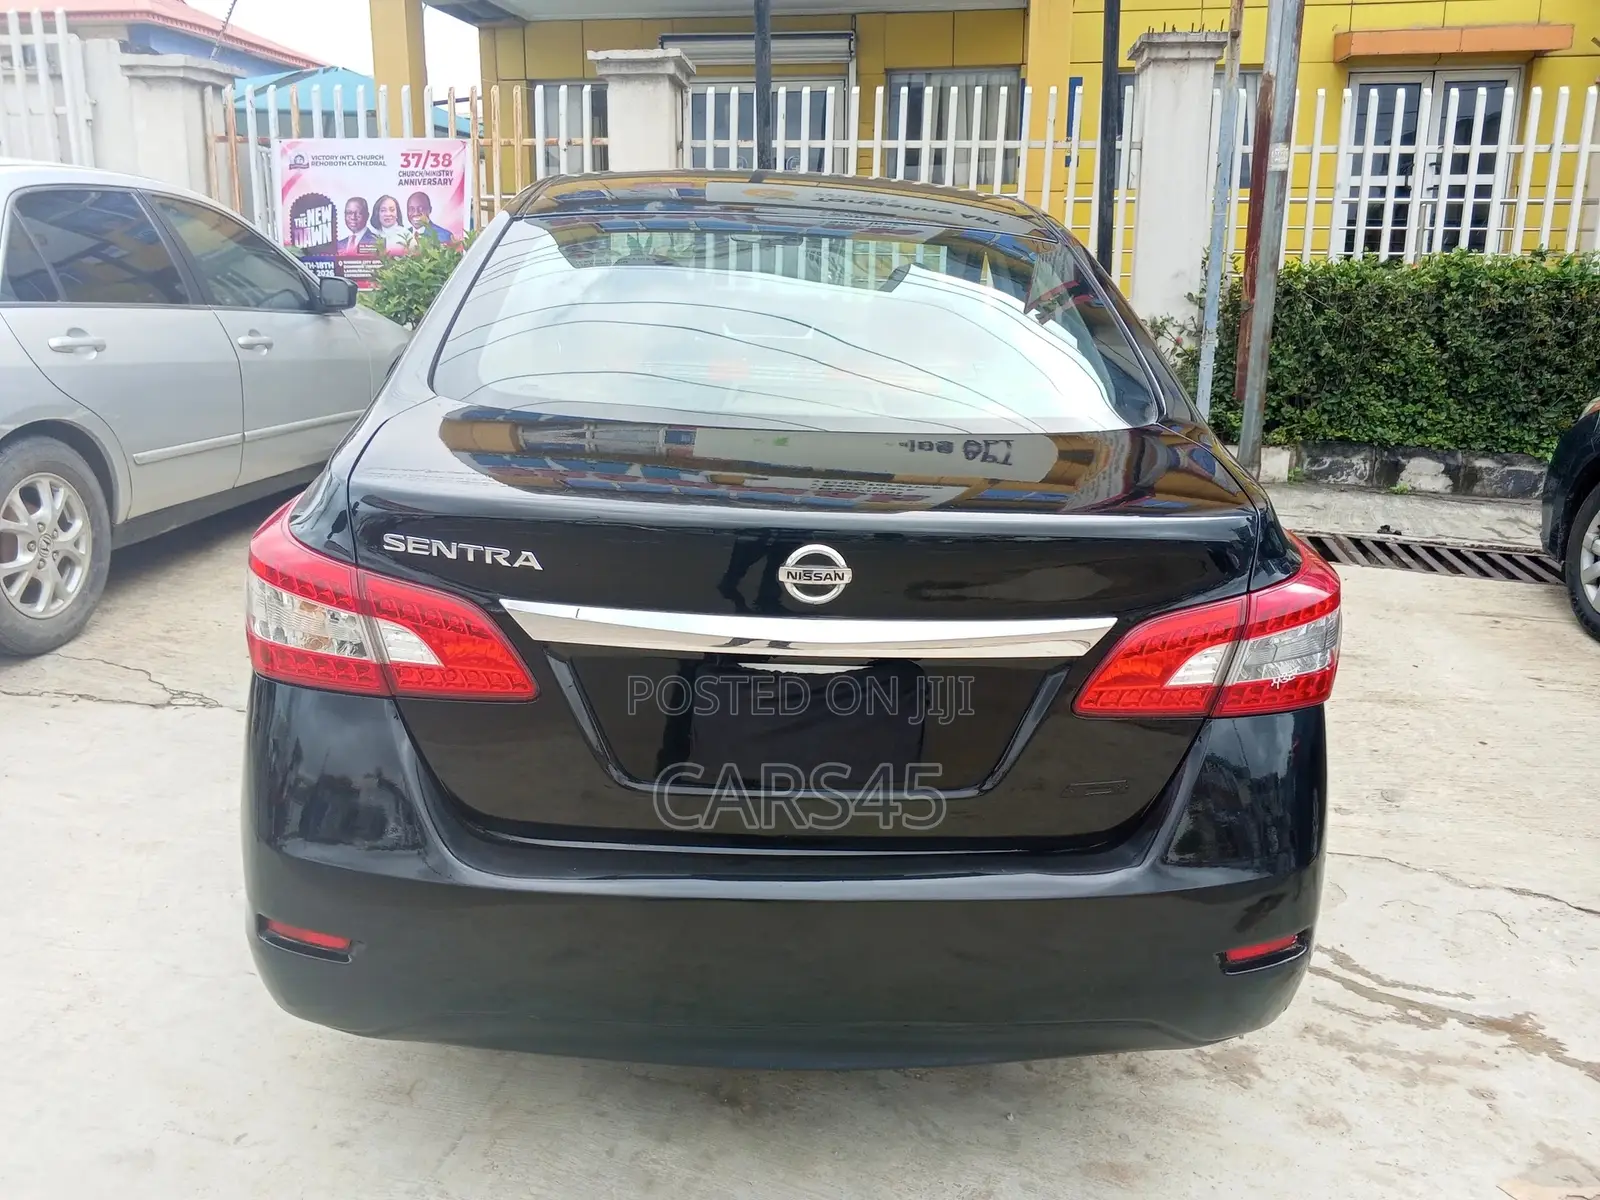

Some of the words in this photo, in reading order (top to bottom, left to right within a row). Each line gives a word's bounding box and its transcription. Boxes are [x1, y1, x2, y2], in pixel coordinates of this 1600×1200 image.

[400, 150, 453, 170] 37/38
[397, 178, 454, 186] ANNIVERSARY
[398, 170, 454, 178] CHURCH/MINISTRY
[293, 217, 307, 228] THE
[306, 204, 332, 227] NEW
[294, 222, 332, 249] DAWN
[382, 533, 544, 571] SENTRA
[786, 570, 845, 581] NISSAN
